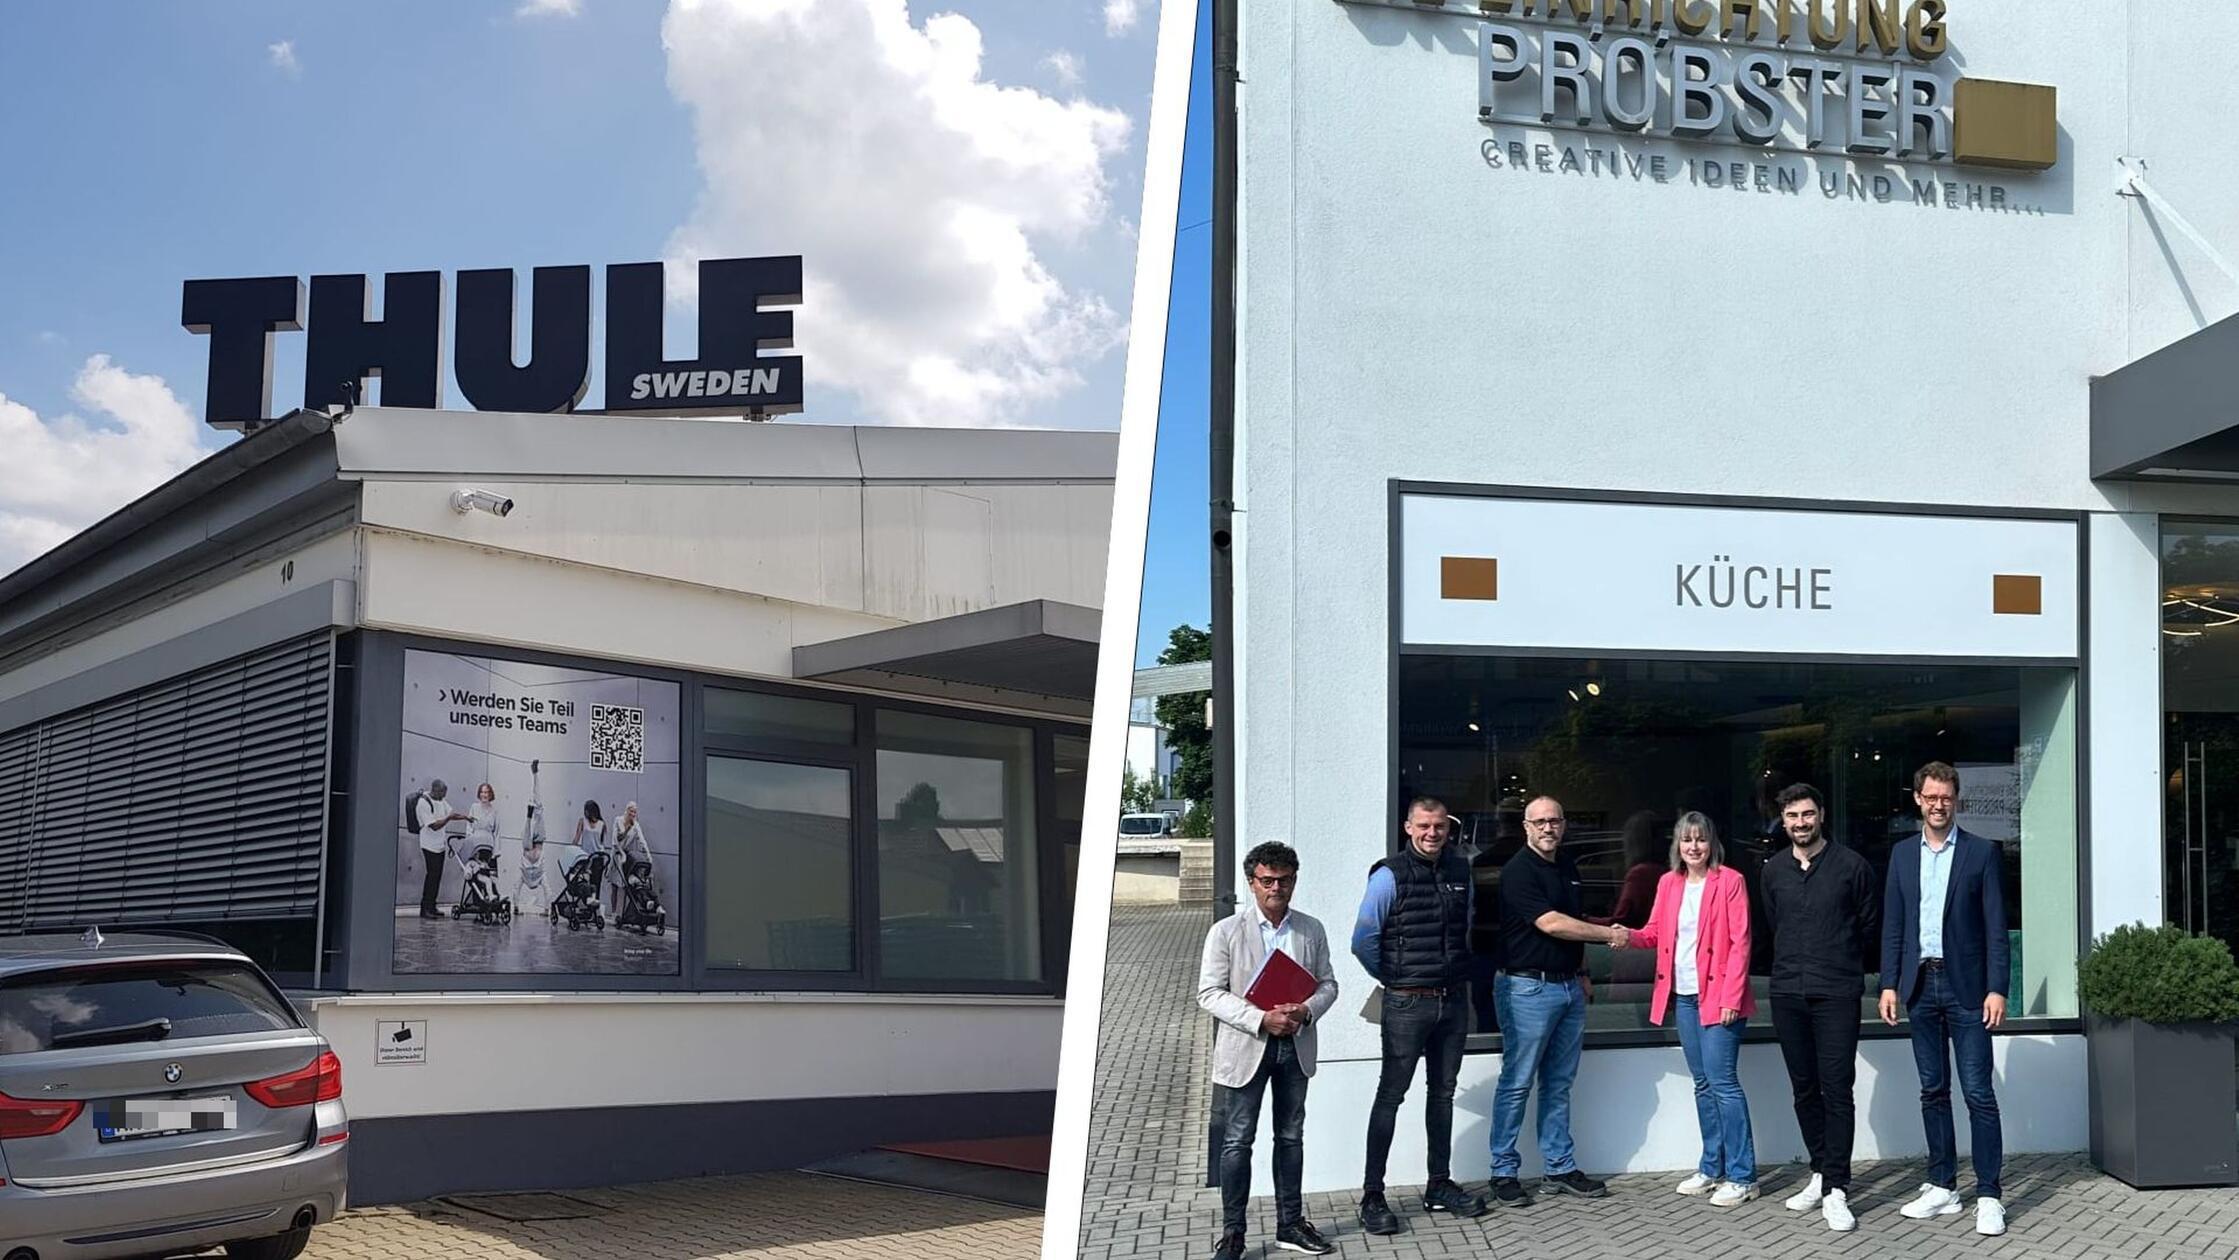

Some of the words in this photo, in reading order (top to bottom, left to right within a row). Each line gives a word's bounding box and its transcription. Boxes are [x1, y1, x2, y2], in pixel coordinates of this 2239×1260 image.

[1480, 0, 1948, 59] CHTUNG
[1480, 138, 1666, 178] CREATIVE
[1688, 158, 1797, 193] IDEEN
[1819, 169, 1892, 200] UND
[181, 255, 803, 424] THULE
[631, 367, 780, 400] SWEDEN
[280, 560, 294, 585] 10
[1676, 554, 1832, 610] KÜCHE
[449, 711, 513, 729] unseres
[517, 715, 567, 735] Teams
[450, 688, 516, 711] Werden
[520, 697, 544, 713] Sie
[548, 699, 574, 717] Teil
